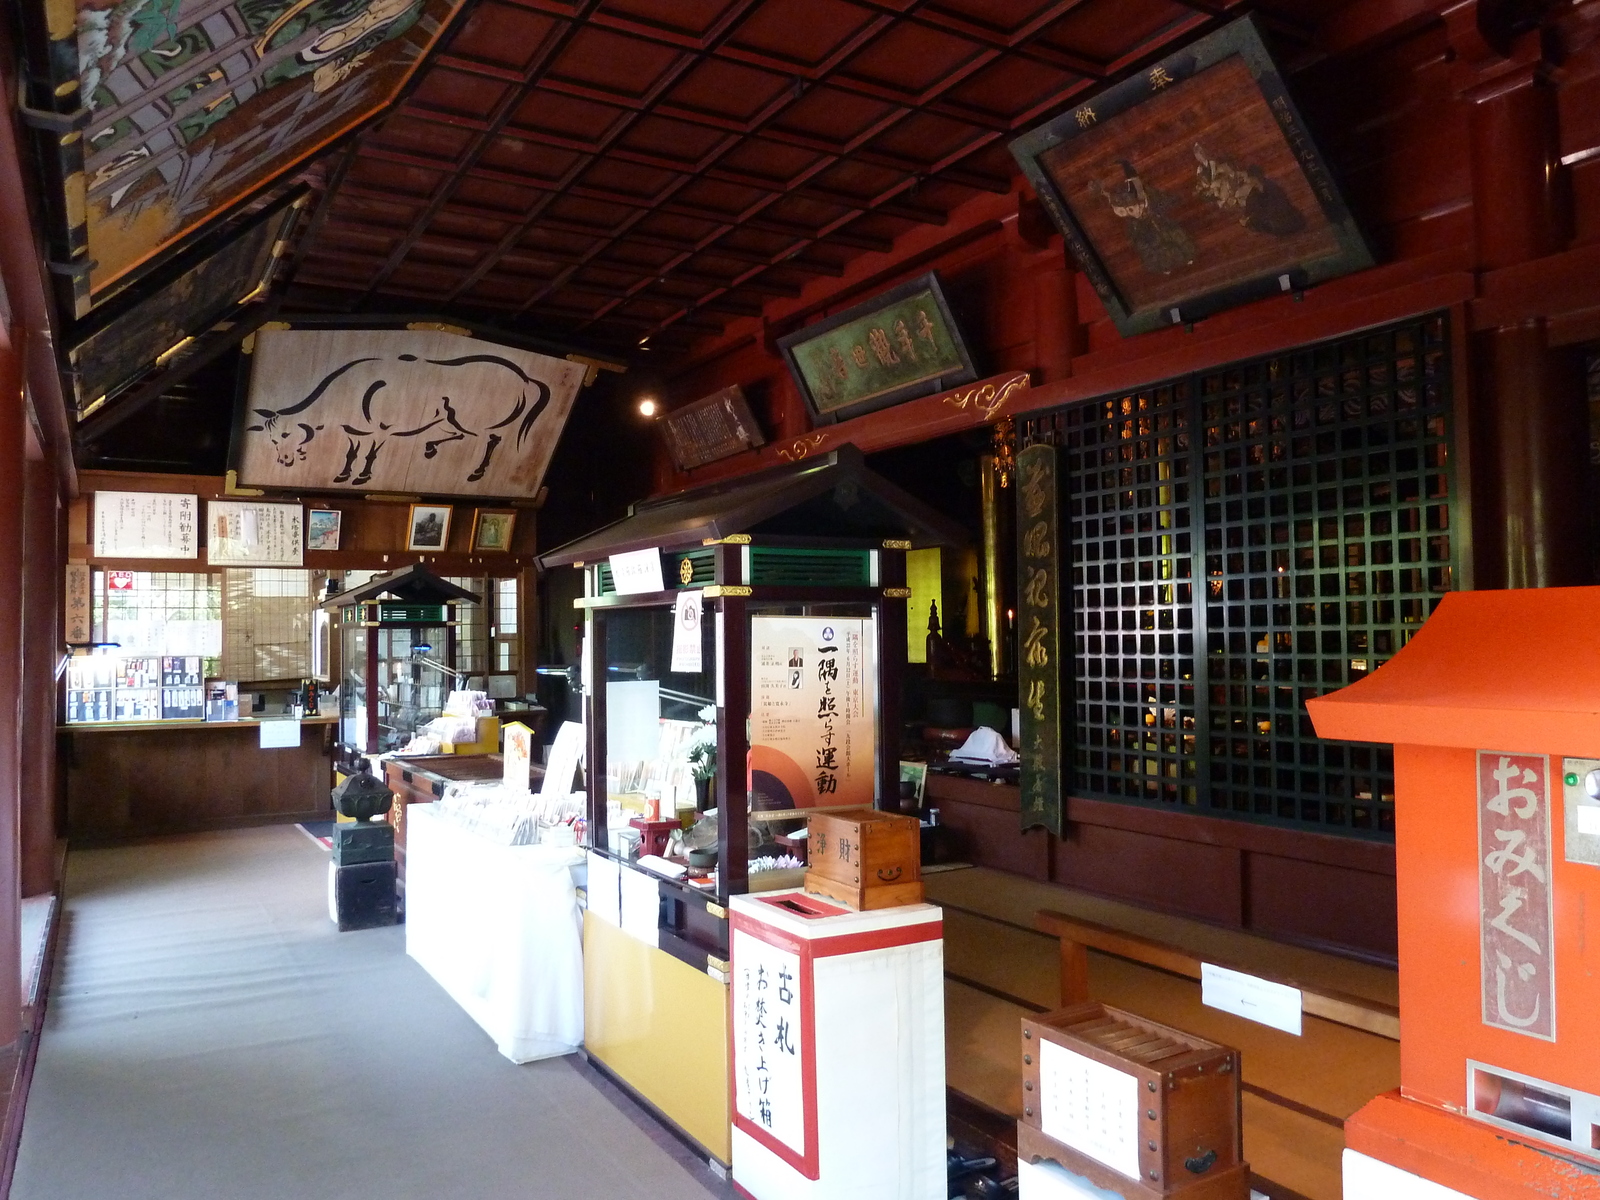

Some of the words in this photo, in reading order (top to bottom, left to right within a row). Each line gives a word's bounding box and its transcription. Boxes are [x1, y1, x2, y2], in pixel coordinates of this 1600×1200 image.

[70, 596, 86, 642] 第六番
[110, 571, 132, 579] AED
[814, 645, 839, 794] 一隅を照らす運動
[815, 832, 852, 864] 浄財
[1484, 756, 1546, 1028] おみくじ
[755, 963, 773, 1128] お焚き上げ箱
[774, 963, 796, 1056] 古札
